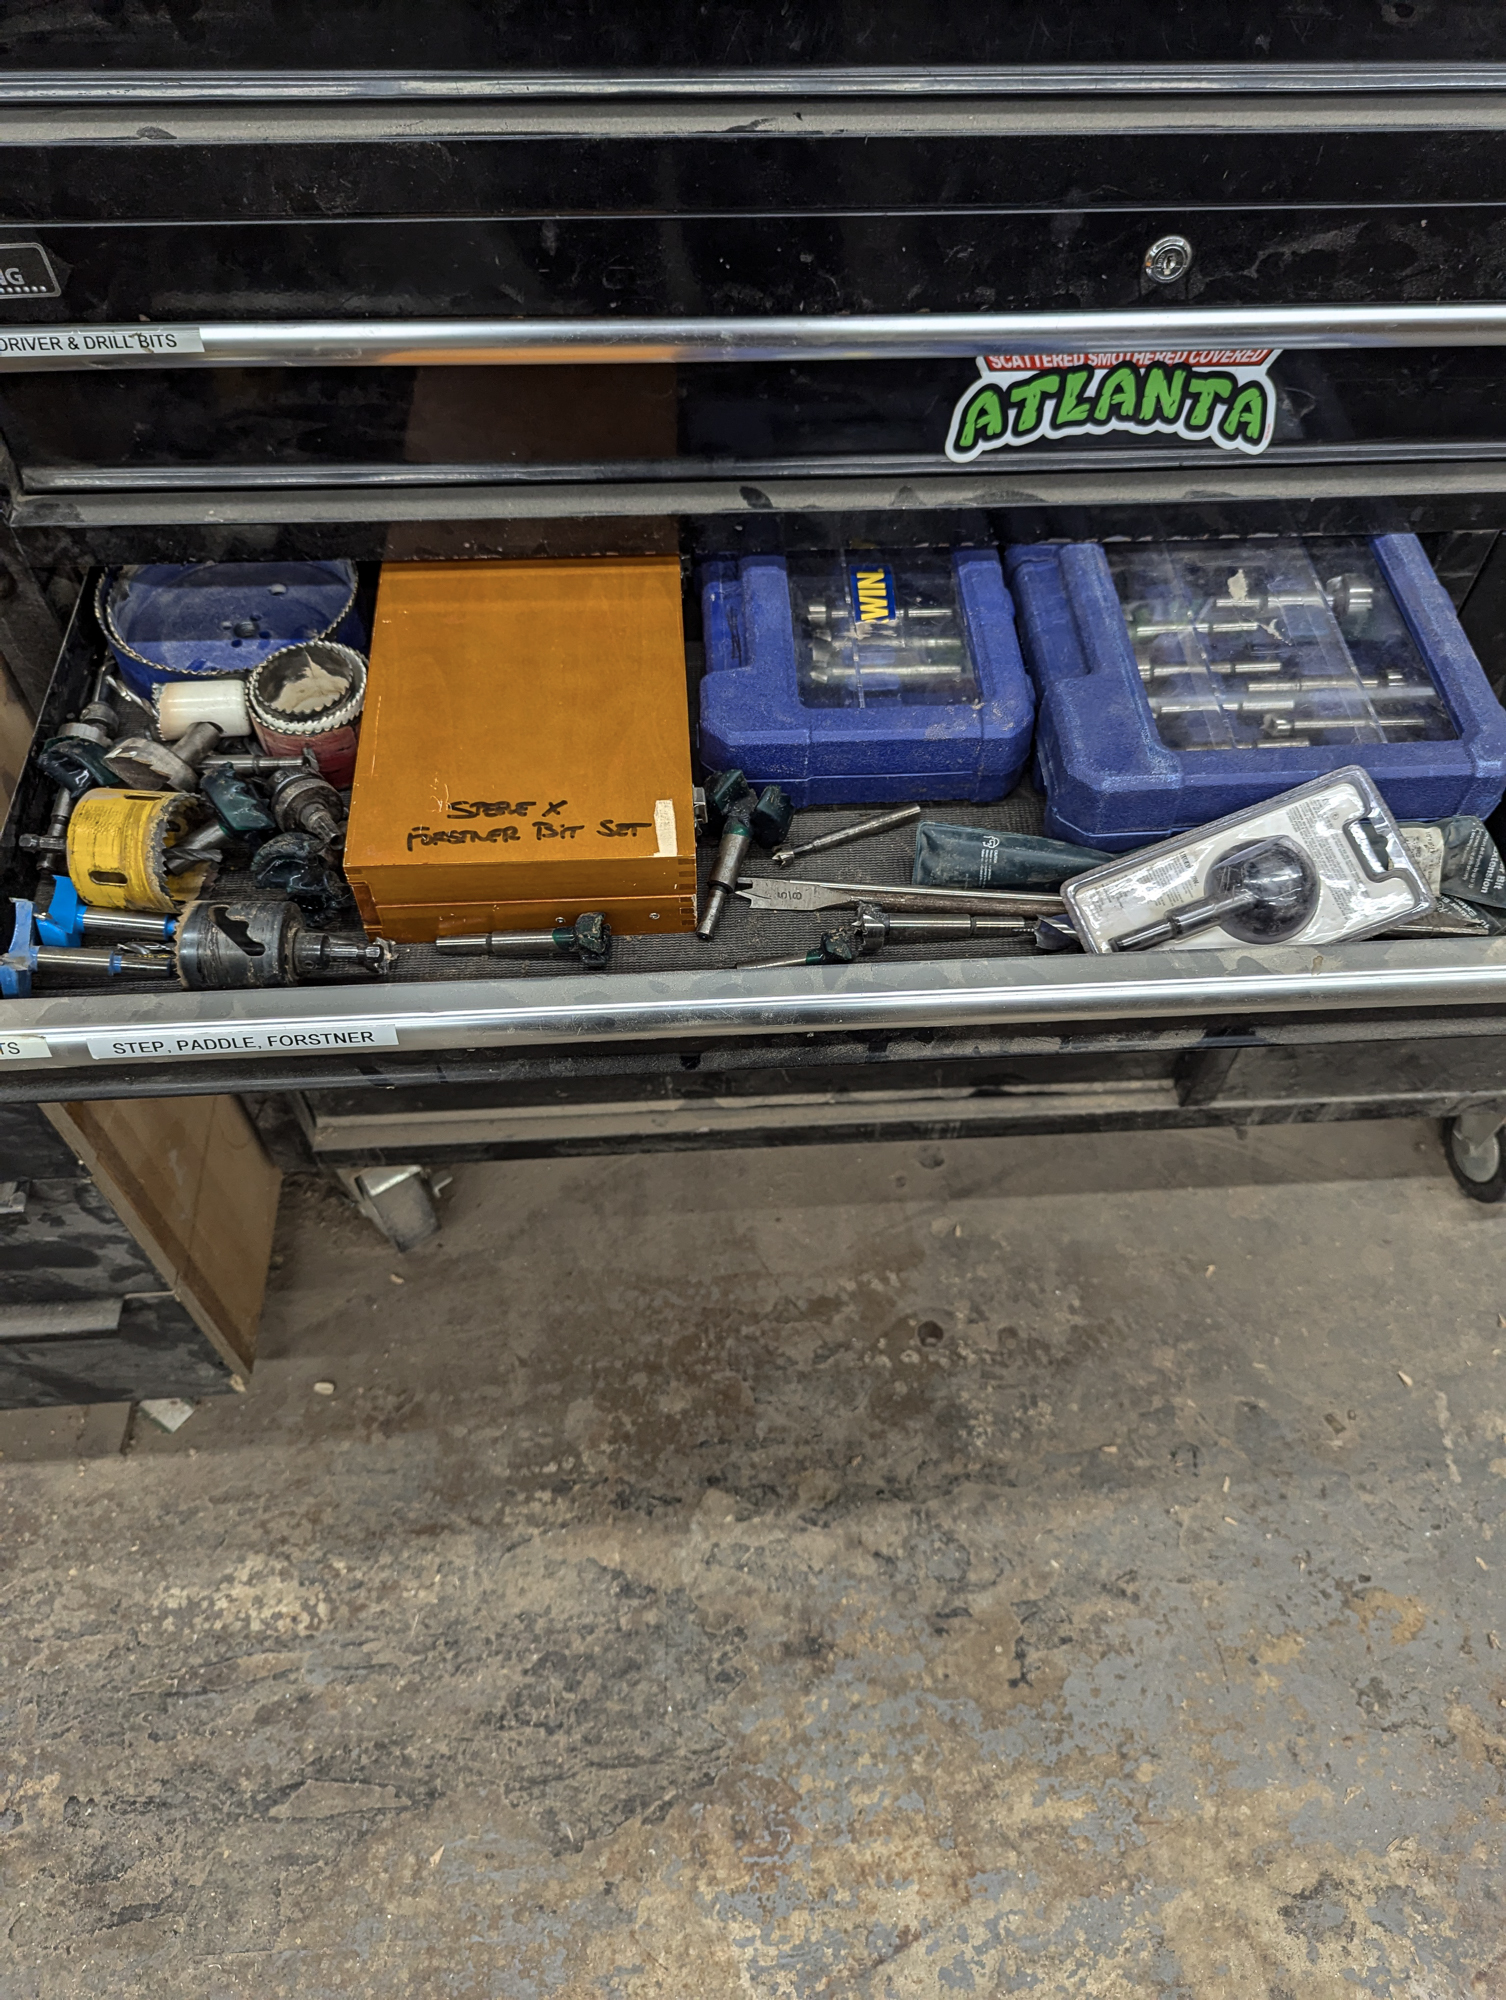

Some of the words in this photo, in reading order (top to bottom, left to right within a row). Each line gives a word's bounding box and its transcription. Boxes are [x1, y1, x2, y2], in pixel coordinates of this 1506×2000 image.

[67, 337, 79, 350] &
[84, 335, 134, 350] DRILL
[138, 333, 177, 348] BITS
[991, 353, 1084, 369] SCATTERED
[1088, 351, 1187, 367] SMOTHERED
[1189, 350, 1271, 365] COVERED
[960, 367, 1263, 447] ATLANTA
[856, 569, 890, 623] WIN
[597, 819, 652, 838] SET
[113, 1040, 171, 1056] STEP,
[177, 1036, 262, 1052] PADDLE,
[267, 1030, 376, 1047] FORSTNER
